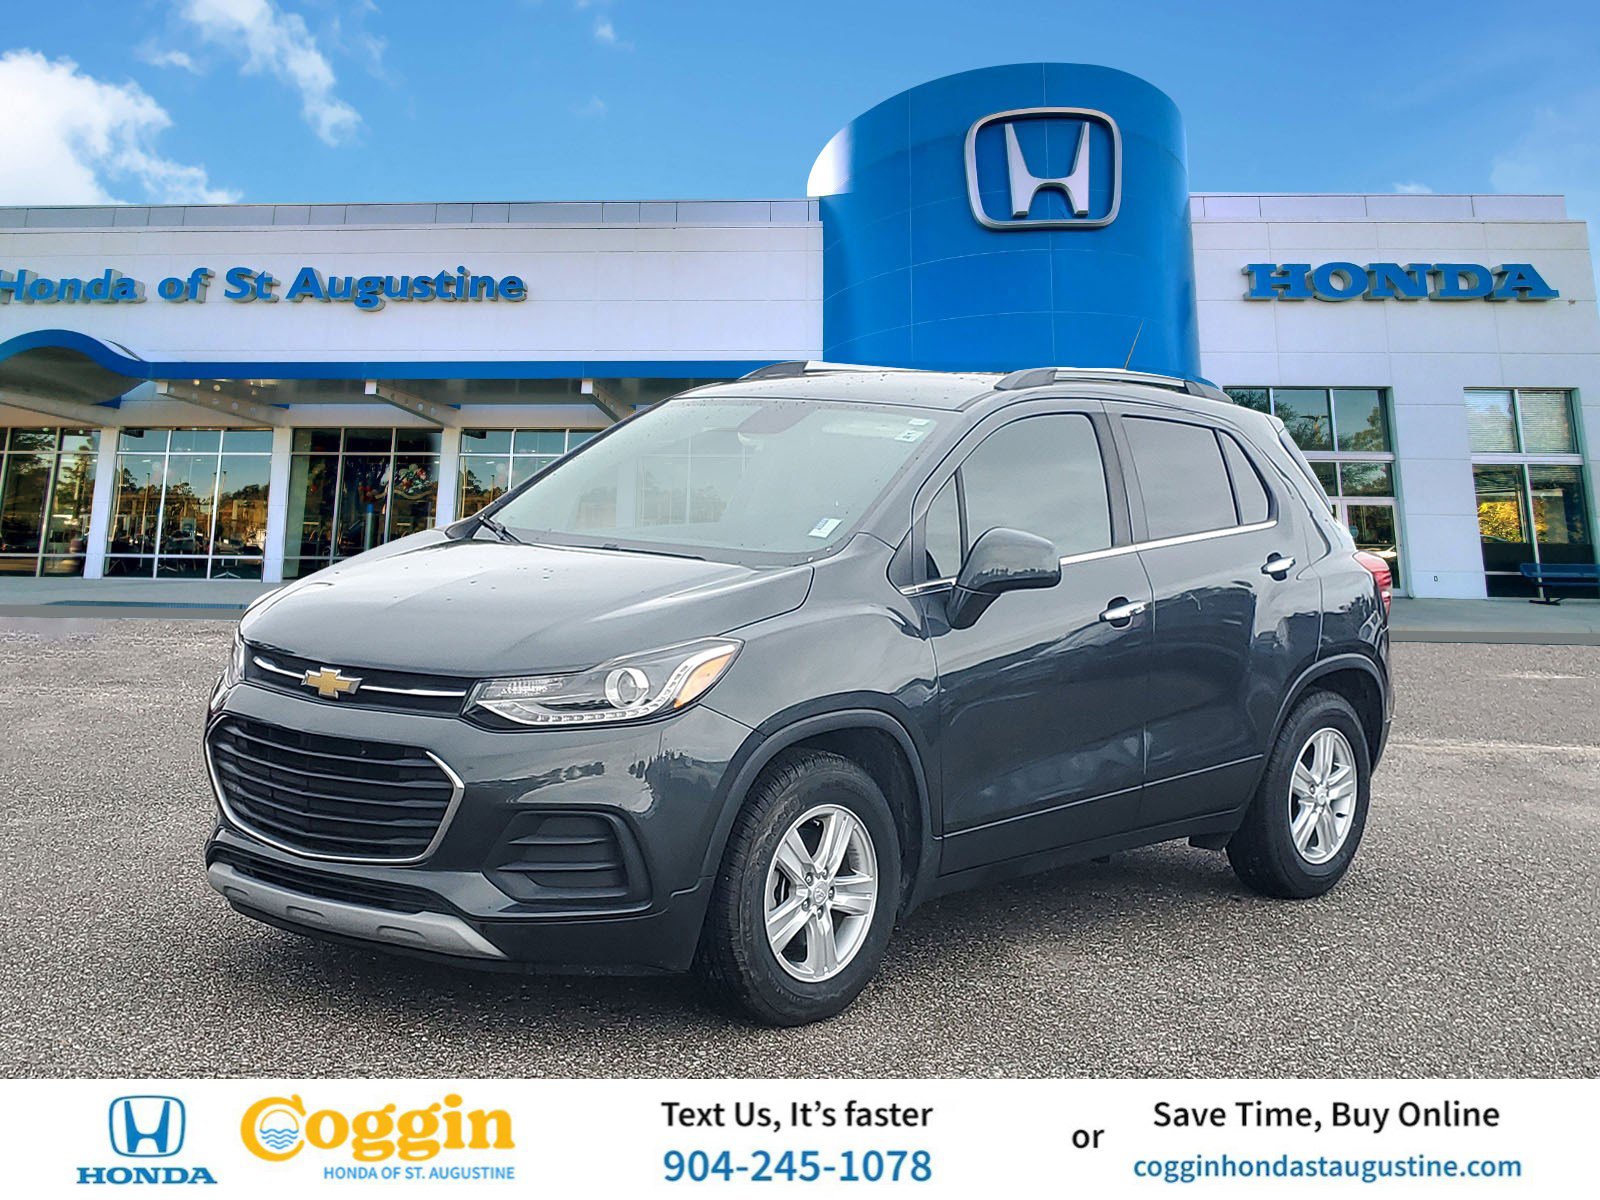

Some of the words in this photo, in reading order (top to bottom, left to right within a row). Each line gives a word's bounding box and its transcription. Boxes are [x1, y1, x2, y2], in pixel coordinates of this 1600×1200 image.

[0, 268, 141, 302] Honda
[157, 267, 210, 302] of
[223, 266, 276, 301] St
[286, 266, 525, 310] Augustine
[1246, 262, 1560, 301] HONDA
